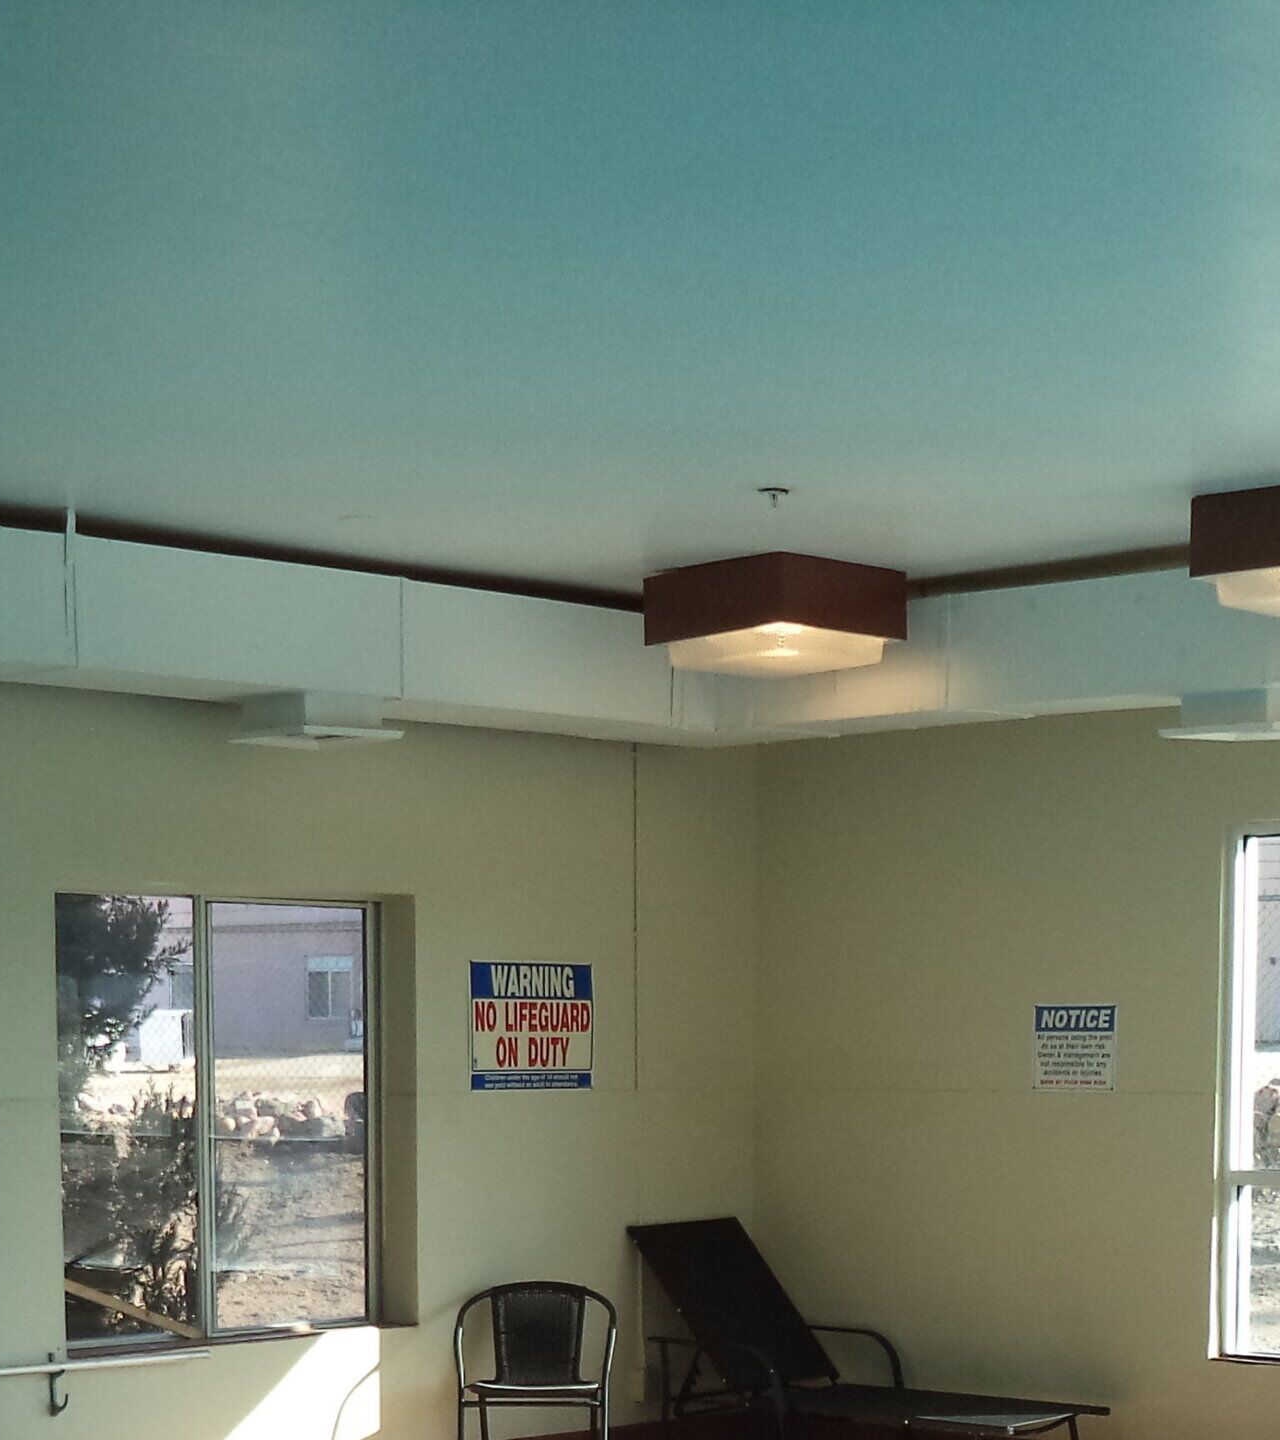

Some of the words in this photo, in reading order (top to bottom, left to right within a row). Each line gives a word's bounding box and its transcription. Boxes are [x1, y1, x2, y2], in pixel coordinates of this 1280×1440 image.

[491, 964, 575, 998] WARNING
[474, 1001, 497, 1032] NO
[505, 1001, 591, 1033] LIFEGUARD
[1041, 1009, 1112, 1028] NOTICE
[496, 1036, 518, 1068] ON
[528, 1036, 570, 1068] DUTY
